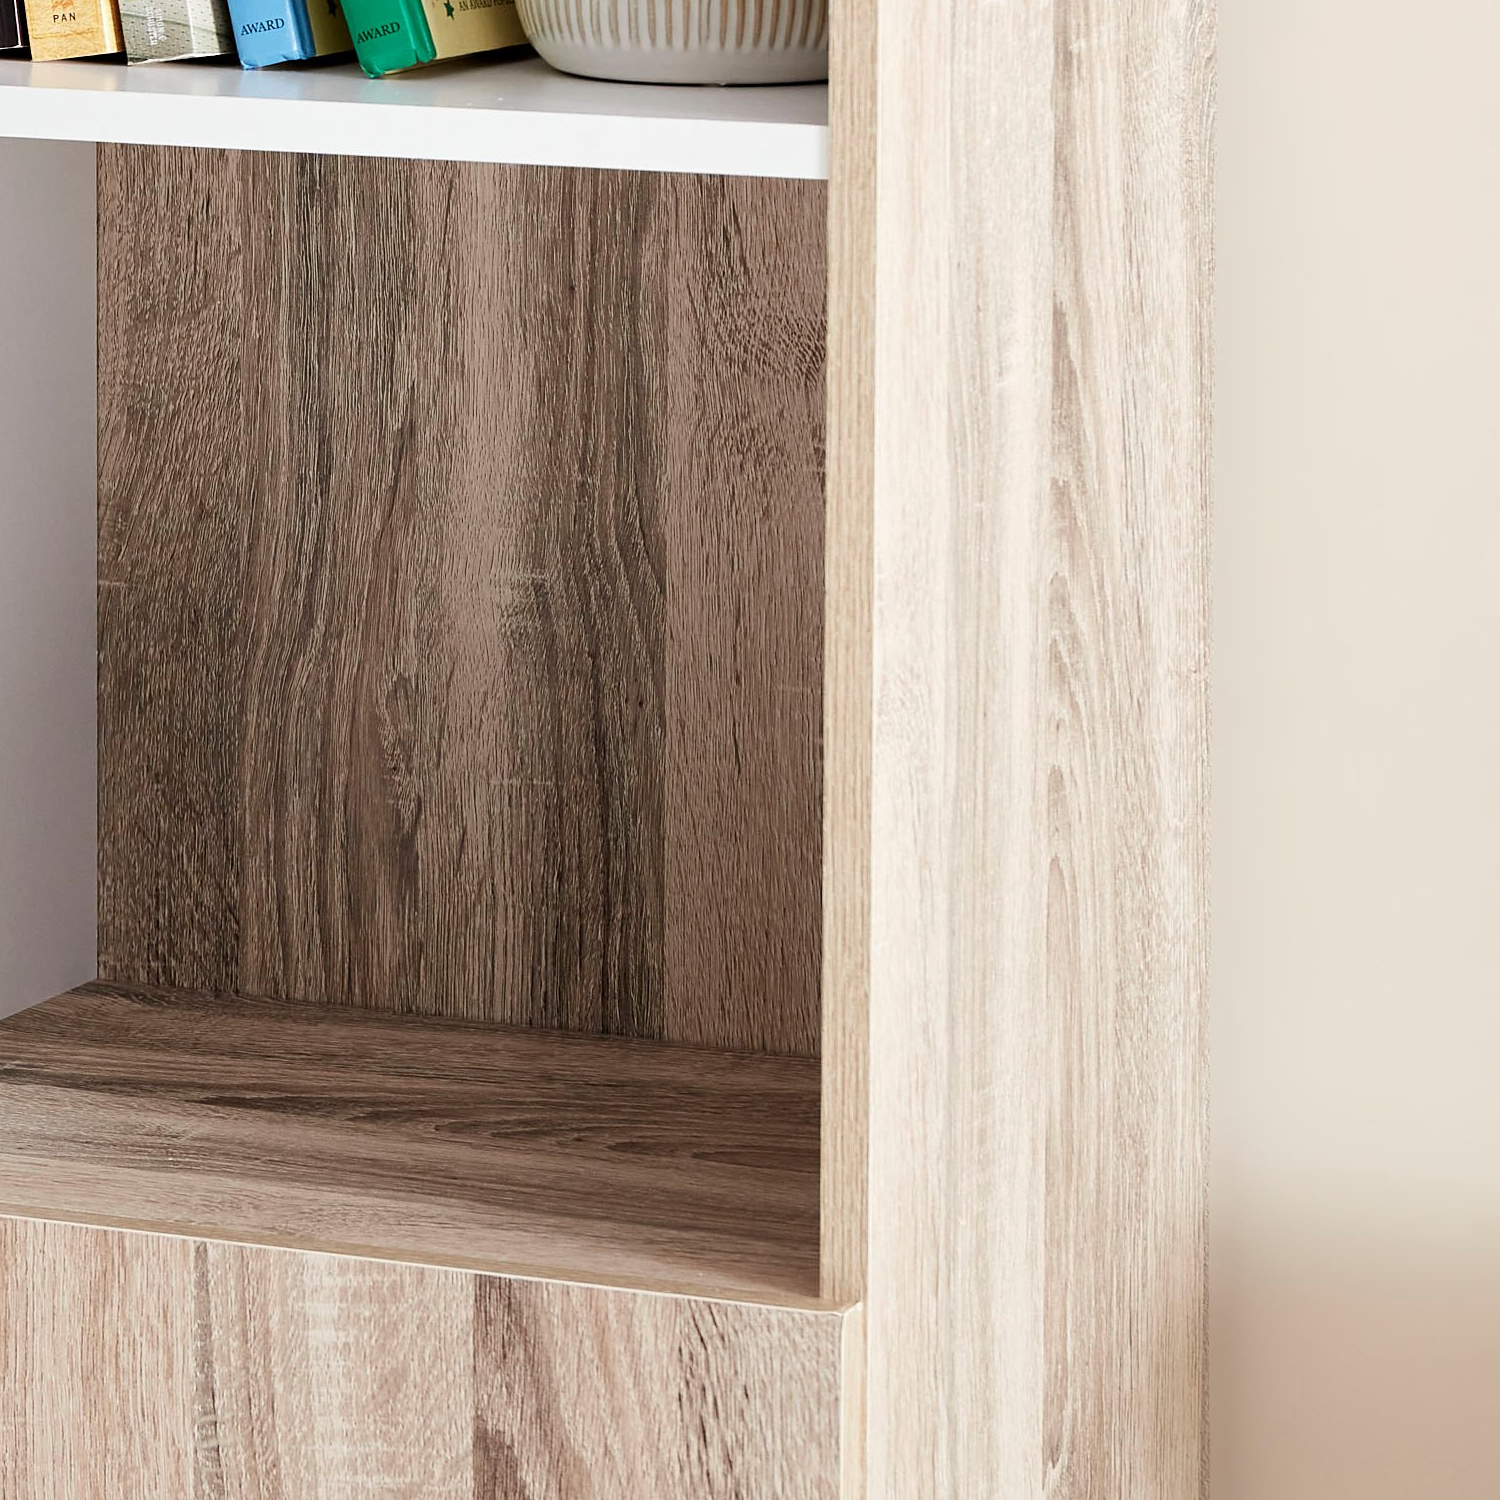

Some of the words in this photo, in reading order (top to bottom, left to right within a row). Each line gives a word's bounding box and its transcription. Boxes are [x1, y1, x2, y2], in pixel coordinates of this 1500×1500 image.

[459, 0, 469, 12] AN
[53, 12, 77, 23] PAN
[240, 18, 285, 36] AWARD
[357, 21, 402, 45] AWARD
